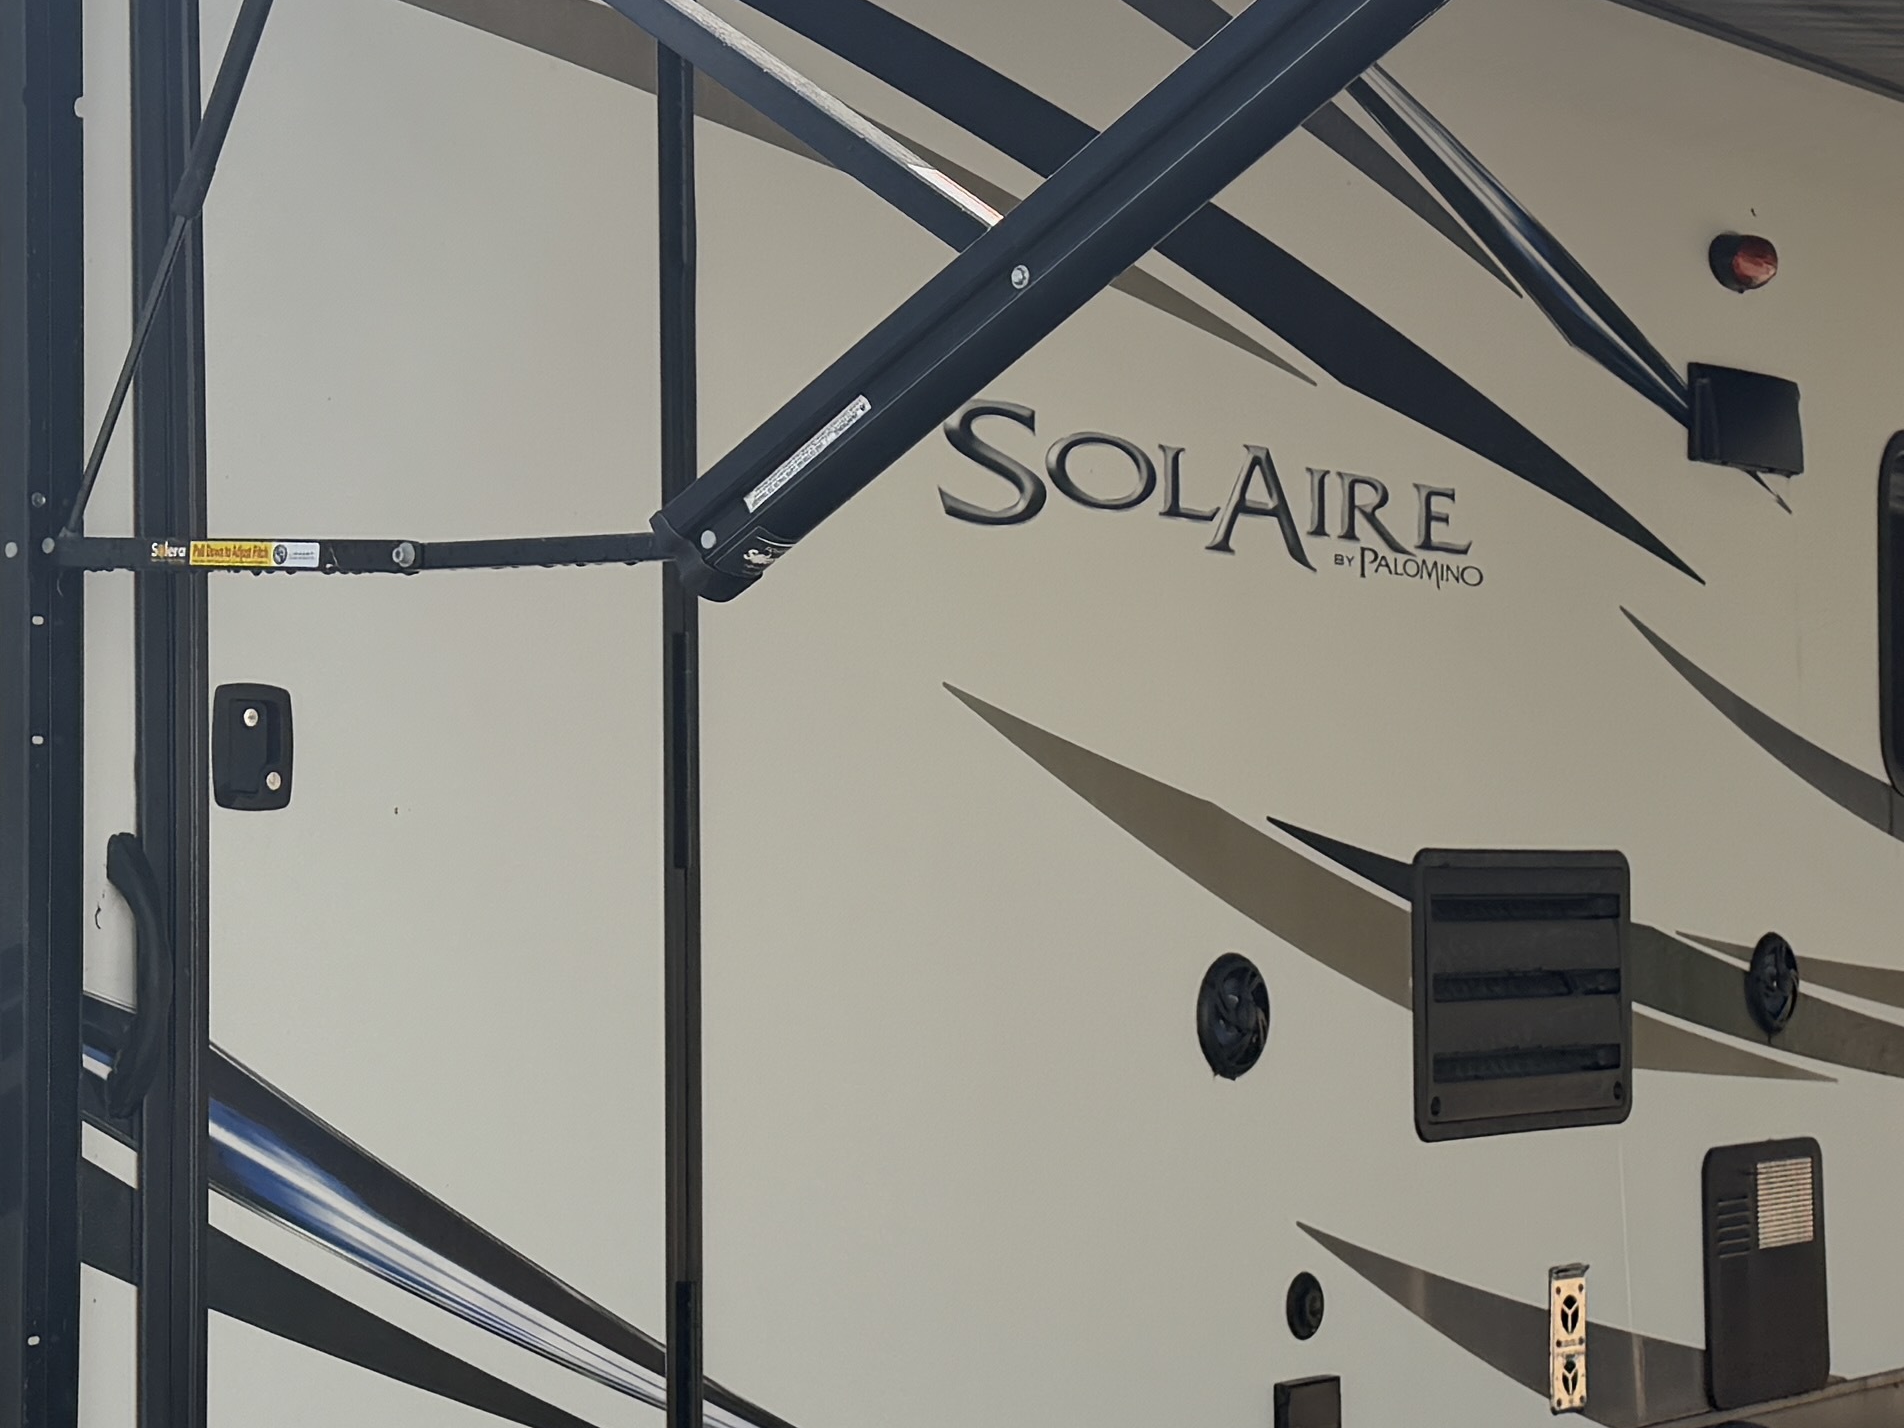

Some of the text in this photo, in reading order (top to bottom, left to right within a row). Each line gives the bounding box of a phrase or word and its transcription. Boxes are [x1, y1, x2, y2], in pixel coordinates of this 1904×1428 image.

[151, 540, 187, 558] Solera
[1334, 546, 1484, 590] BY PALOMINO
